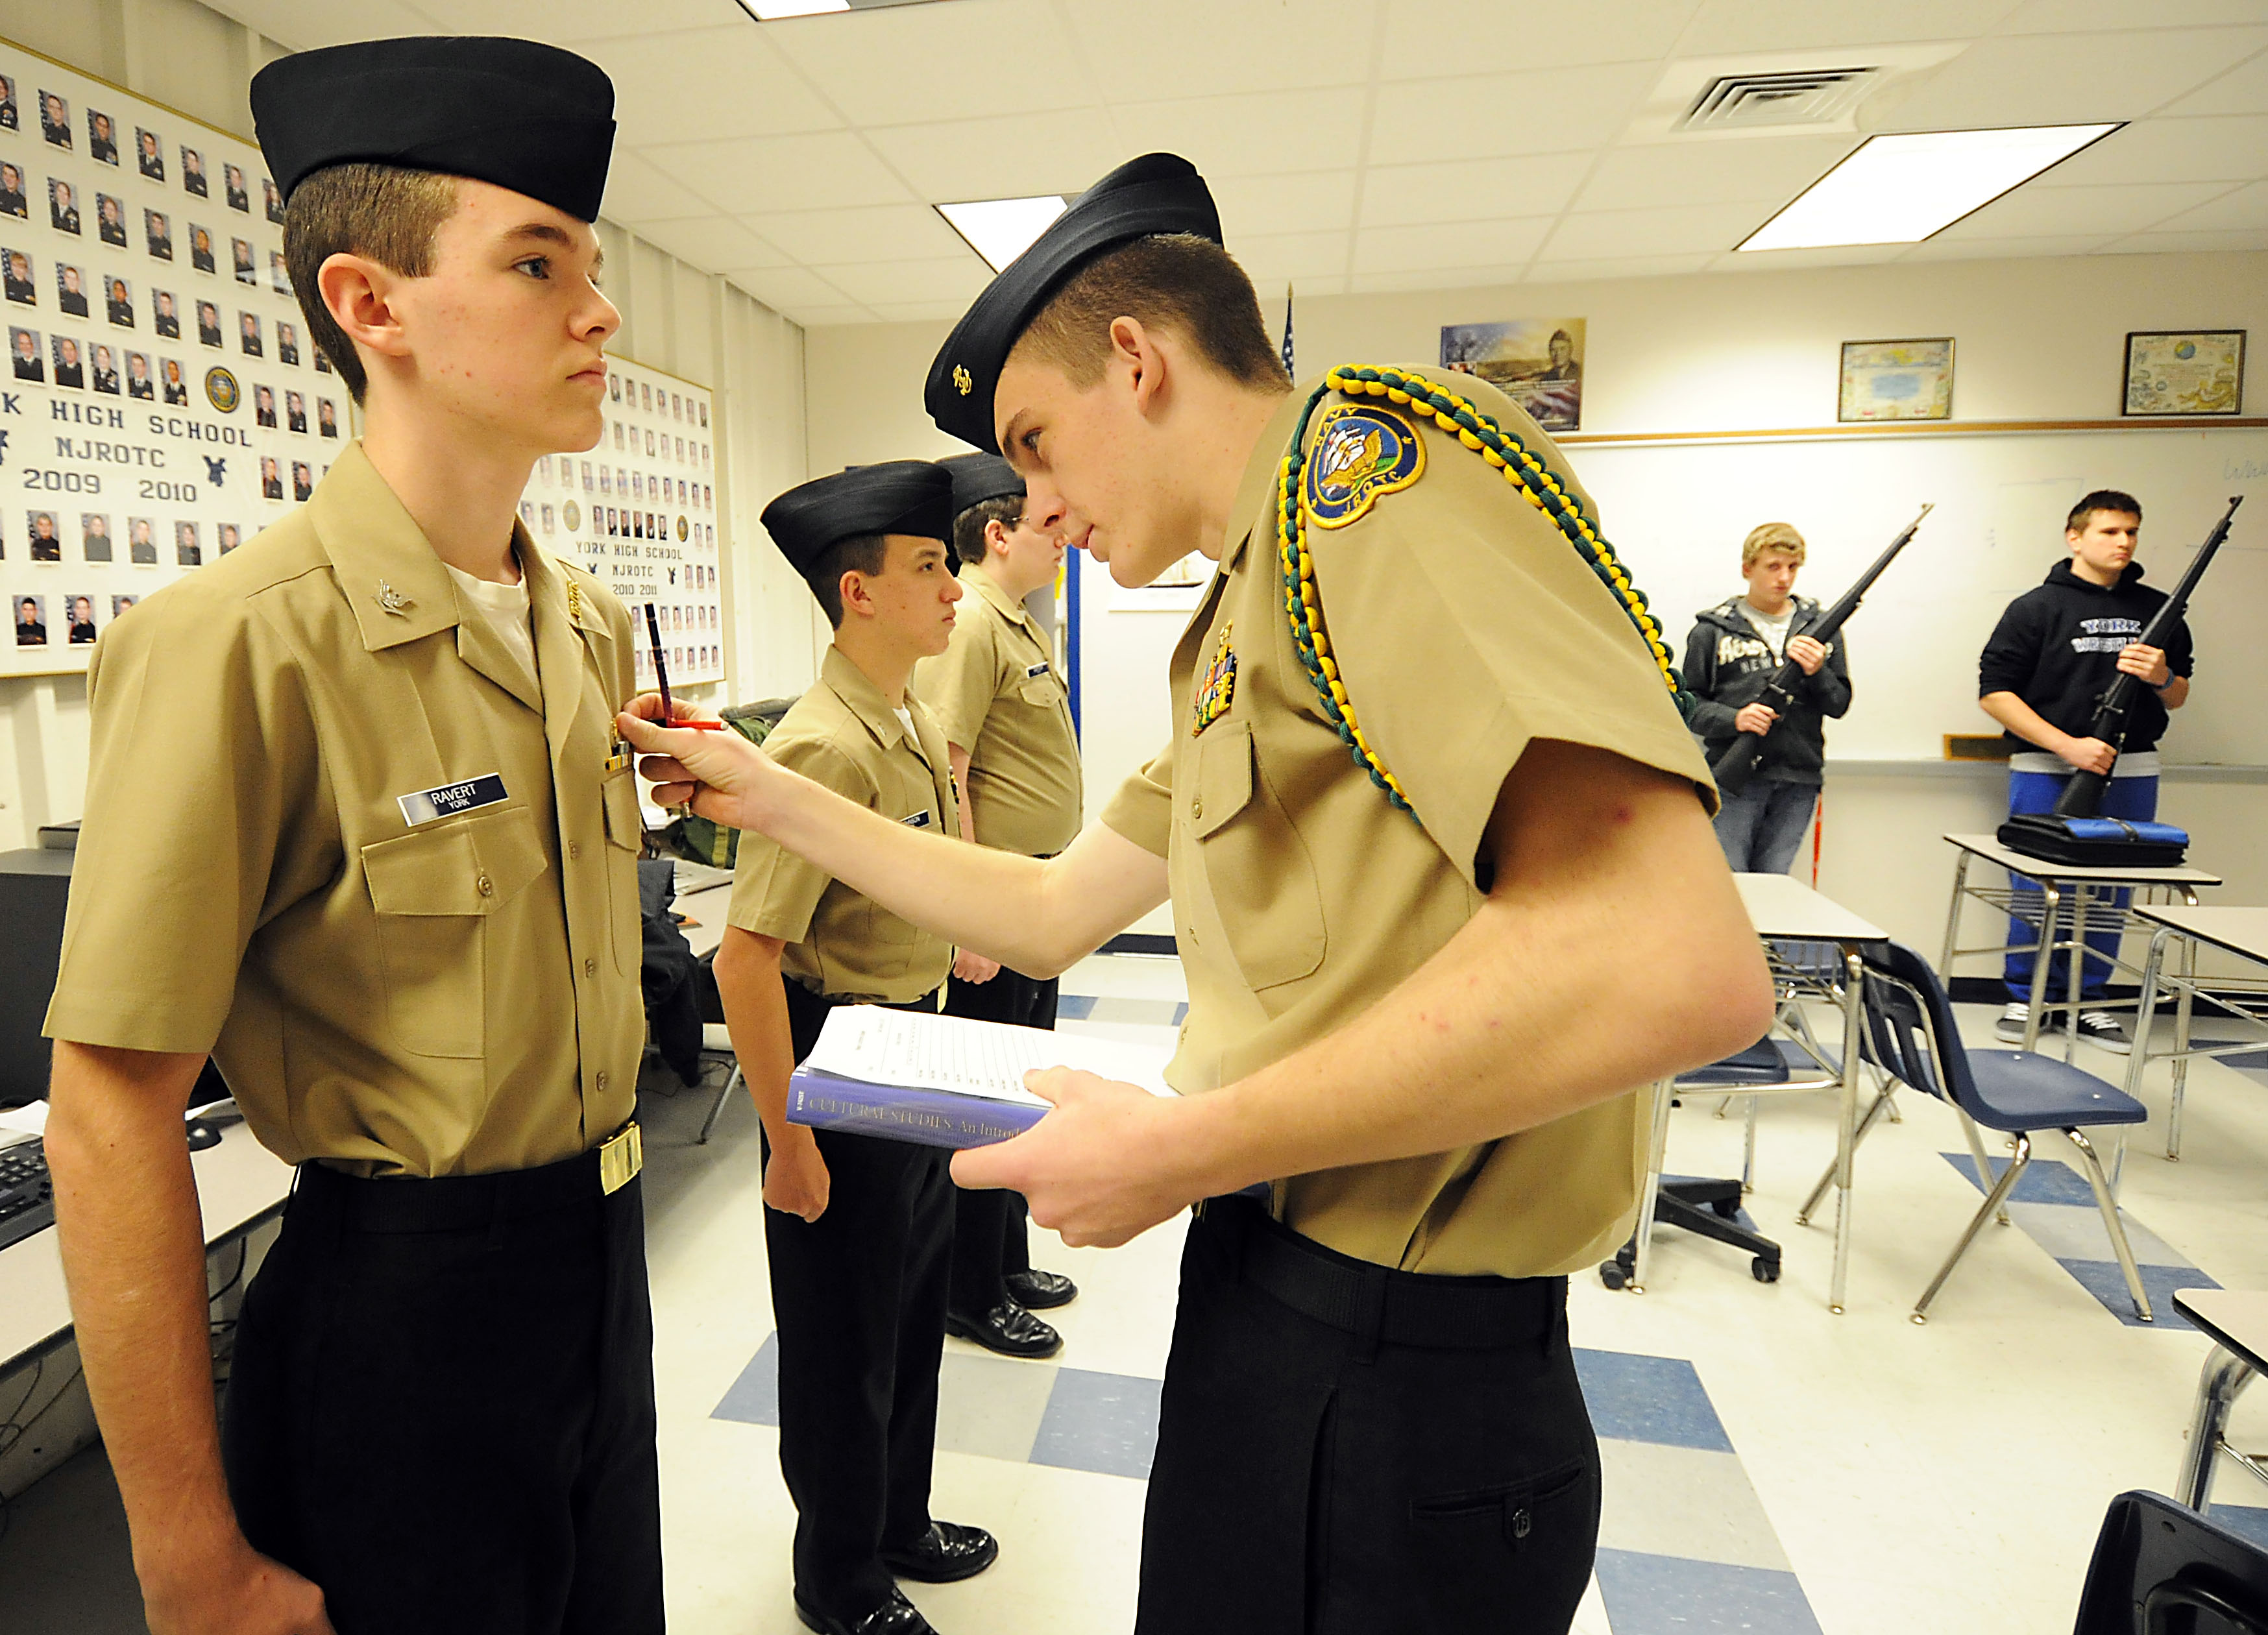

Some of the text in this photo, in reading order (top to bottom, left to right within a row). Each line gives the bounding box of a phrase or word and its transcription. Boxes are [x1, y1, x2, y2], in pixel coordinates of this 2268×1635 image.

[50, 399, 124, 429] HIGH
[149, 415, 252, 447] SCHOOL
[1316, 407, 1358, 446] NAVY
[55, 436, 165, 468] NJROTC
[23, 468, 197, 502] 2009 2010
[1342, 471, 1402, 515] JROTC
[576, 541, 683, 559] YORK HIGH SCHOOL
[612, 564, 653, 577] NJROTC
[613, 584, 657, 596] 2010 2011
[2080, 618, 2141, 634] YORK
[430, 783, 477, 805] RAVERT
[448, 798, 470, 810] YORK
[809, 1098, 884, 1120] CULTURAL
[958, 1120, 976, 1133] An
